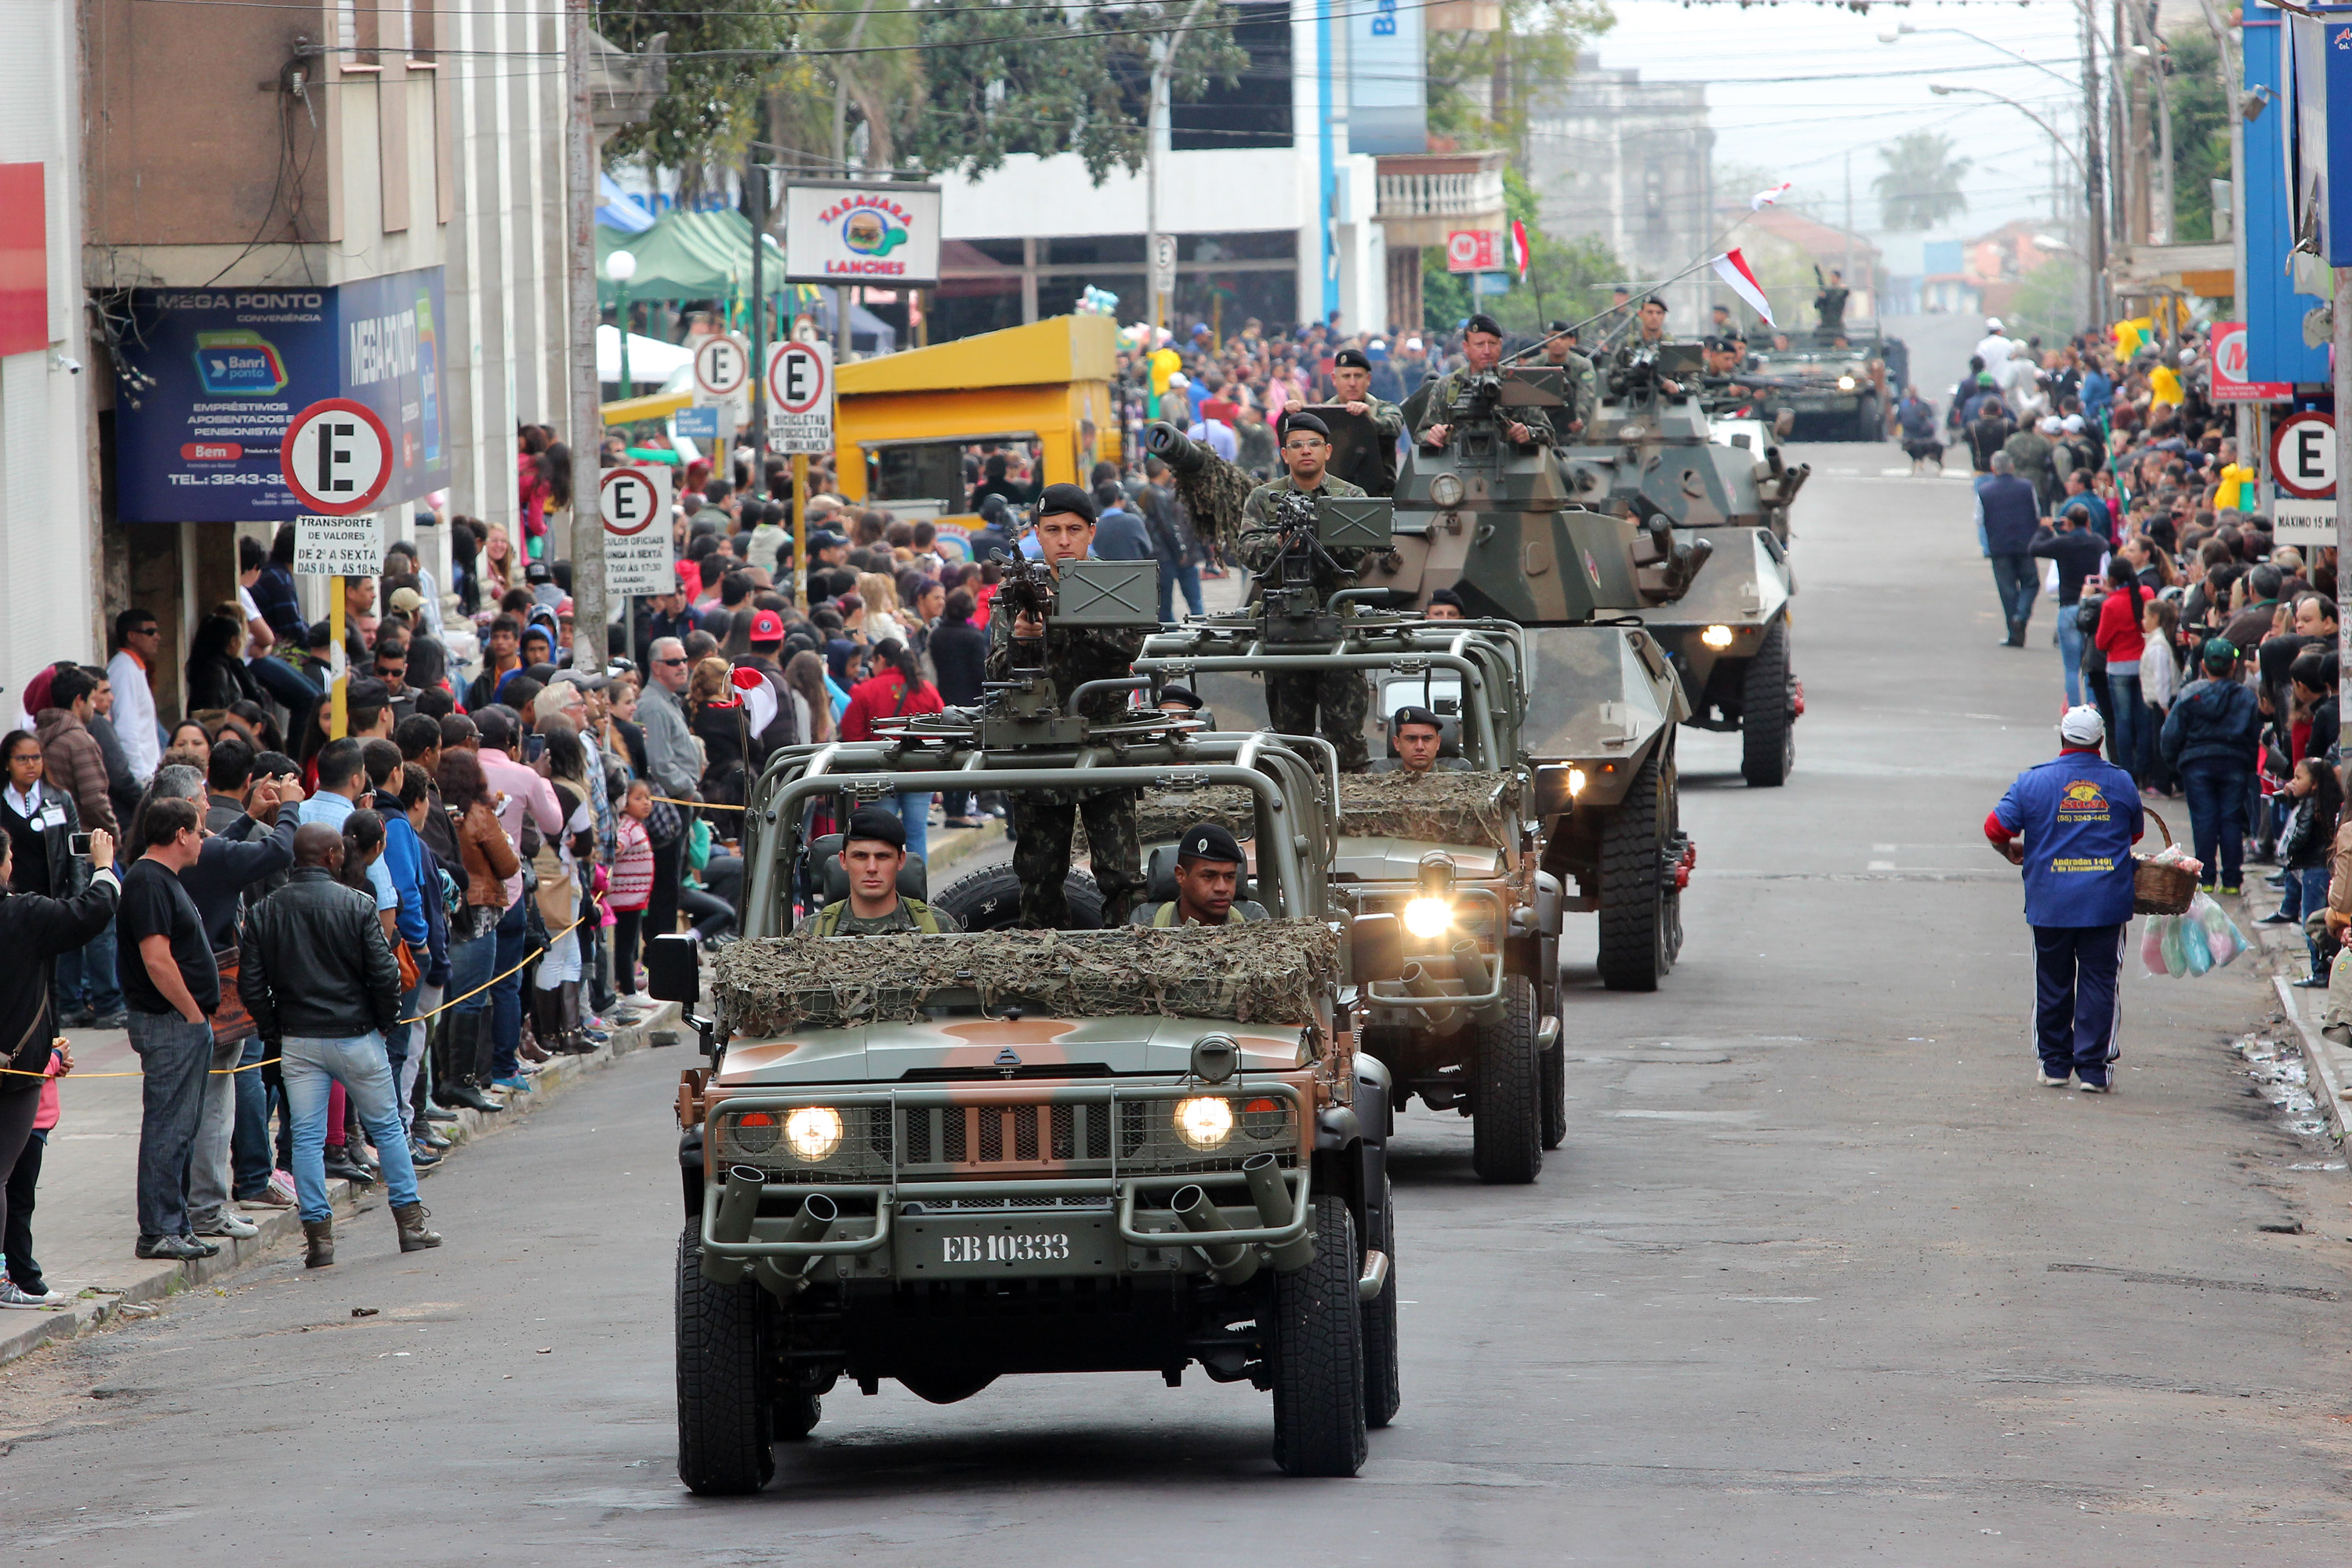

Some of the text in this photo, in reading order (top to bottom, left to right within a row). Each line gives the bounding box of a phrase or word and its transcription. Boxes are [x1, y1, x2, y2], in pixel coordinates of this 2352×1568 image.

[818, 194, 913, 227] TABAJARA
[825, 260, 906, 274] LANCHES
[158, 293, 322, 309] MEGA PONTO
[237, 312, 321, 322] CONVENIÊNCIA
[350, 308, 417, 386] MEGA PONTO
[228, 355, 266, 368] Banri
[712, 348, 728, 383] E
[229, 368, 265, 379] ponto
[787, 355, 806, 400] E
[193, 401, 289, 412] EMPRÉSTIMOS
[187, 415, 285, 424] APOSENTADOS
[774, 415, 826, 426] BICICLETAS
[194, 427, 288, 436] PENSIONISTAS
[195, 445, 227, 458] Bem
[318, 423, 354, 491] E
[2299, 431, 2325, 477] E
[615, 482, 636, 519] E
[301, 517, 372, 528] TRANSPORTE
[2278, 514, 2311, 528] MÁXIMO
[2314, 517, 2323, 529] 15
[308, 532, 365, 541] DE VALORES
[298, 549, 313, 560] DE
[329, 550, 338, 560] A
[340, 550, 377, 561] SEXTA
[298, 562, 317, 574] DAS
[319, 564, 325, 574] 8
[327, 563, 336, 574] h.
[357, 563, 368, 575] 18
[370, 563, 383, 575] hs.
[2060, 800, 2109, 809] SILVA
[942, 1233, 1069, 1262] EB 10333
